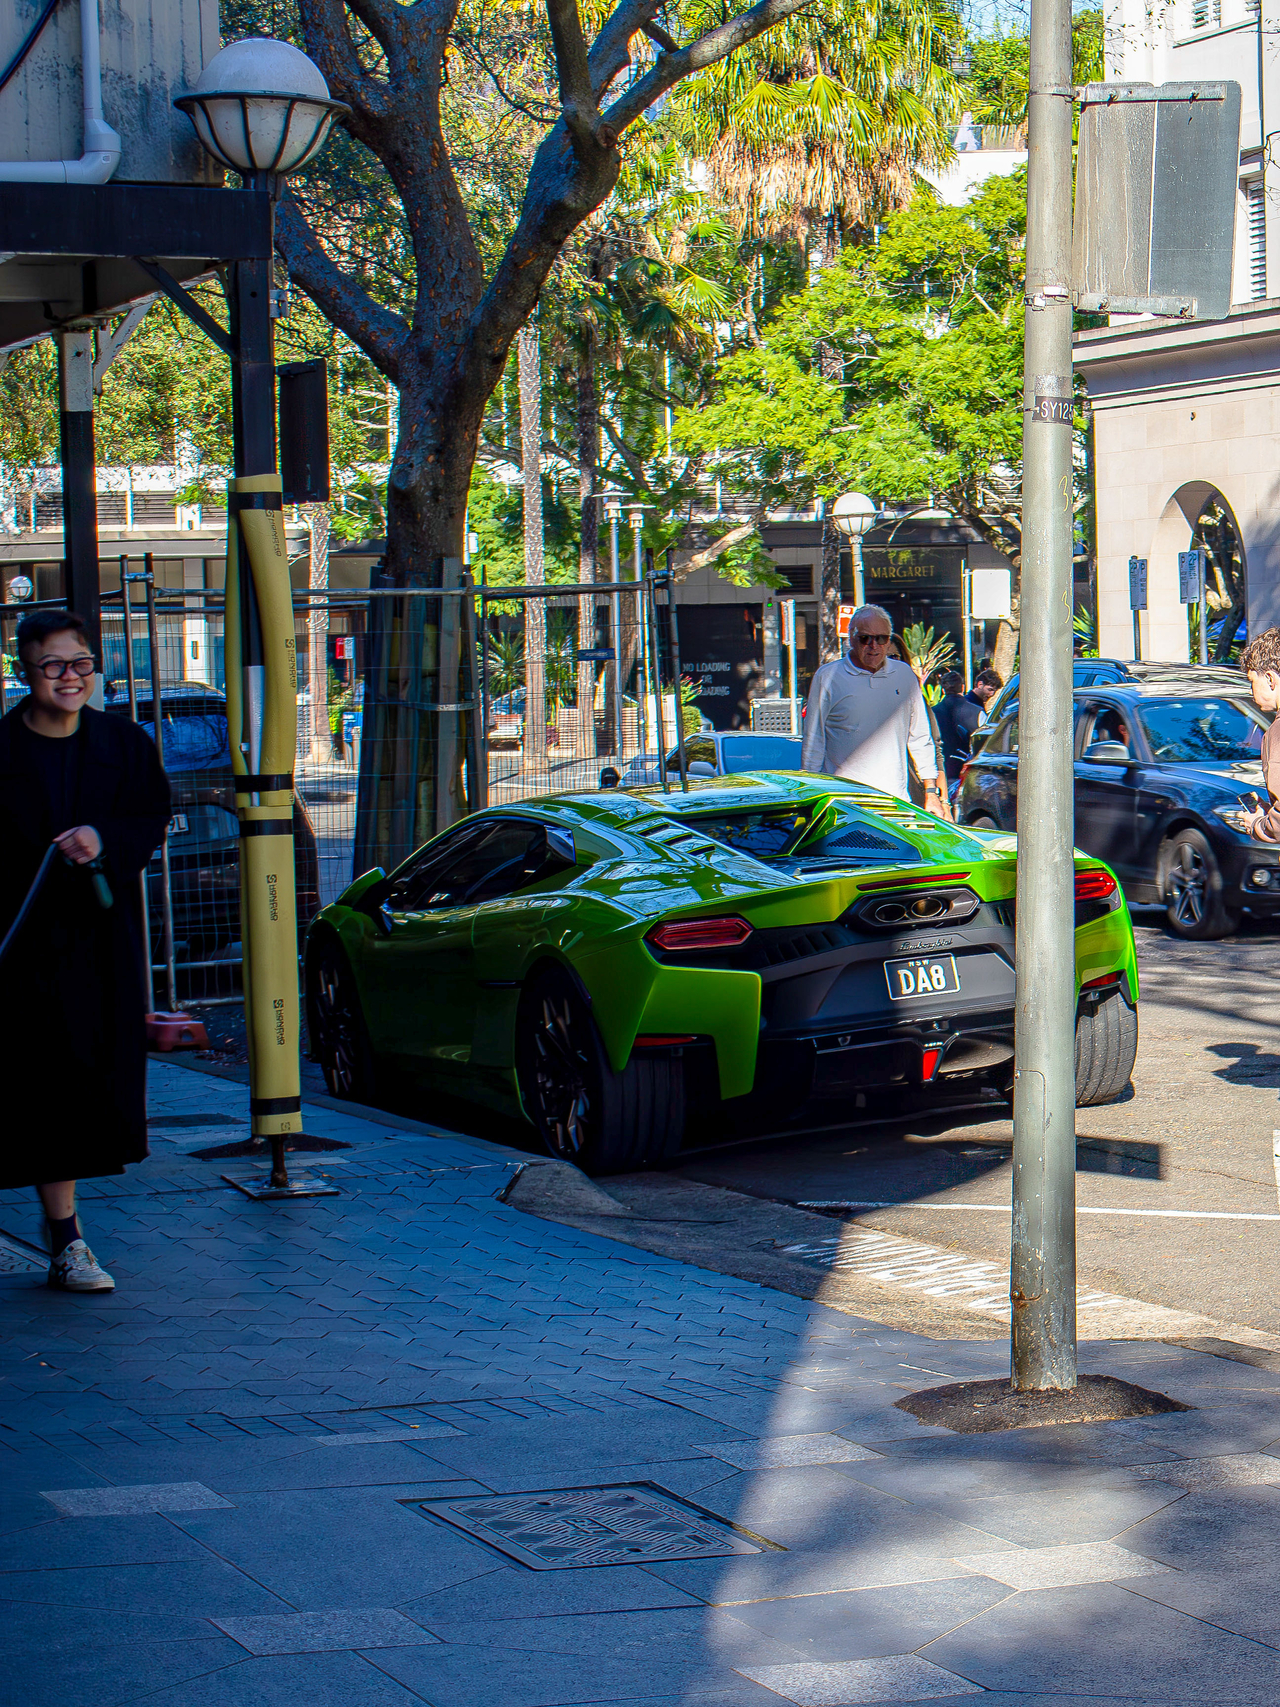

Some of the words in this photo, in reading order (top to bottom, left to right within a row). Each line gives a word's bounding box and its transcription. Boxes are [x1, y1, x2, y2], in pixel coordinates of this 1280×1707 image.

[870, 565, 935, 578] MARGARET
[682, 663, 694, 672] NO
[696, 663, 731, 672] LOADING
[908, 959, 929, 968] NSW
[897, 965, 947, 995] DA8
